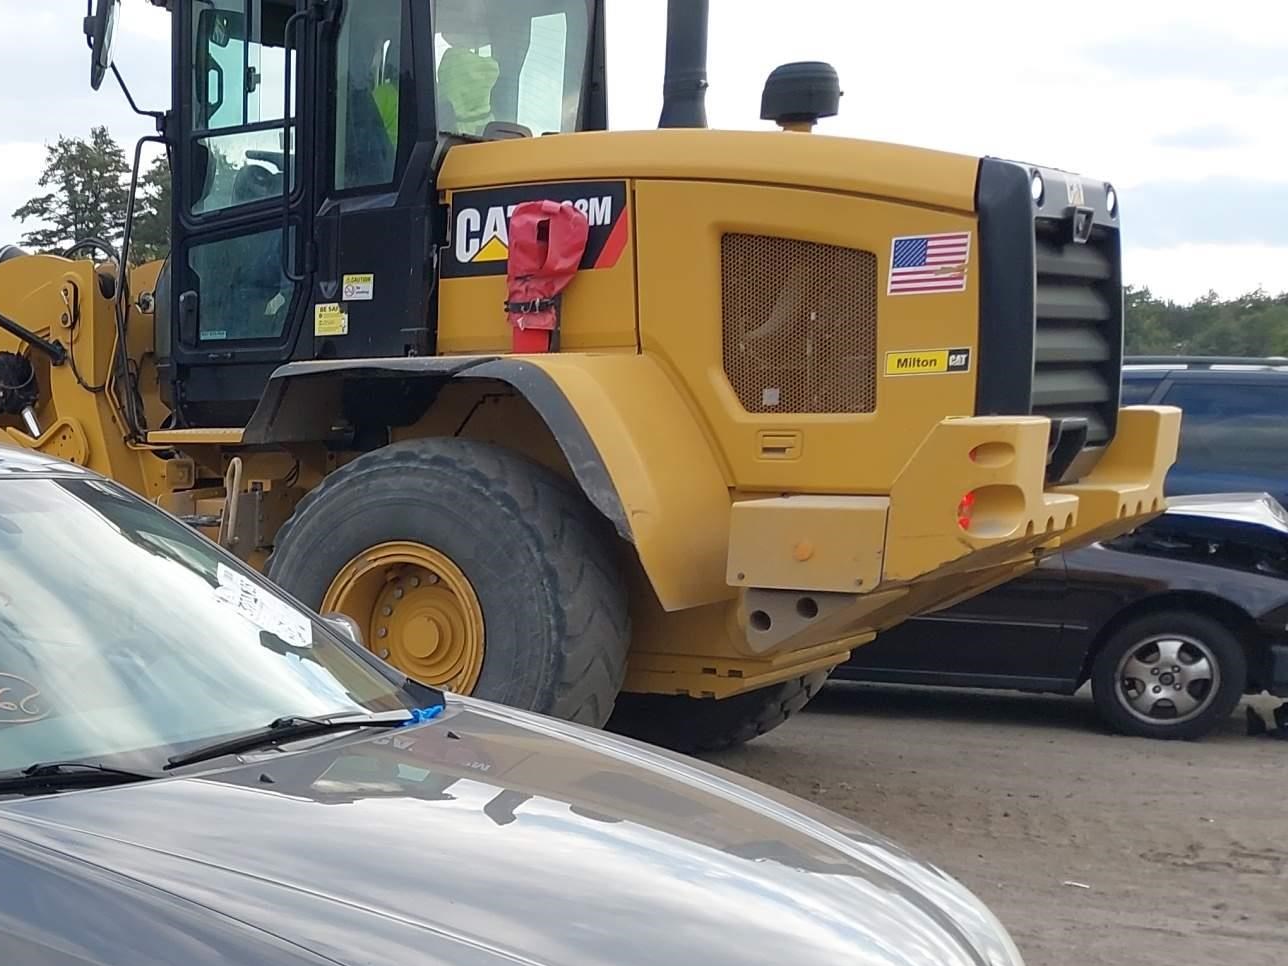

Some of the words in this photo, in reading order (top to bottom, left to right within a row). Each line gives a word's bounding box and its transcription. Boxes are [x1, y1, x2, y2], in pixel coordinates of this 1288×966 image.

[455, 205, 518, 263] CA
[560, 196, 612, 226] 8M
[896, 357, 938, 369] Milton
[948, 354, 968, 367] CAT
